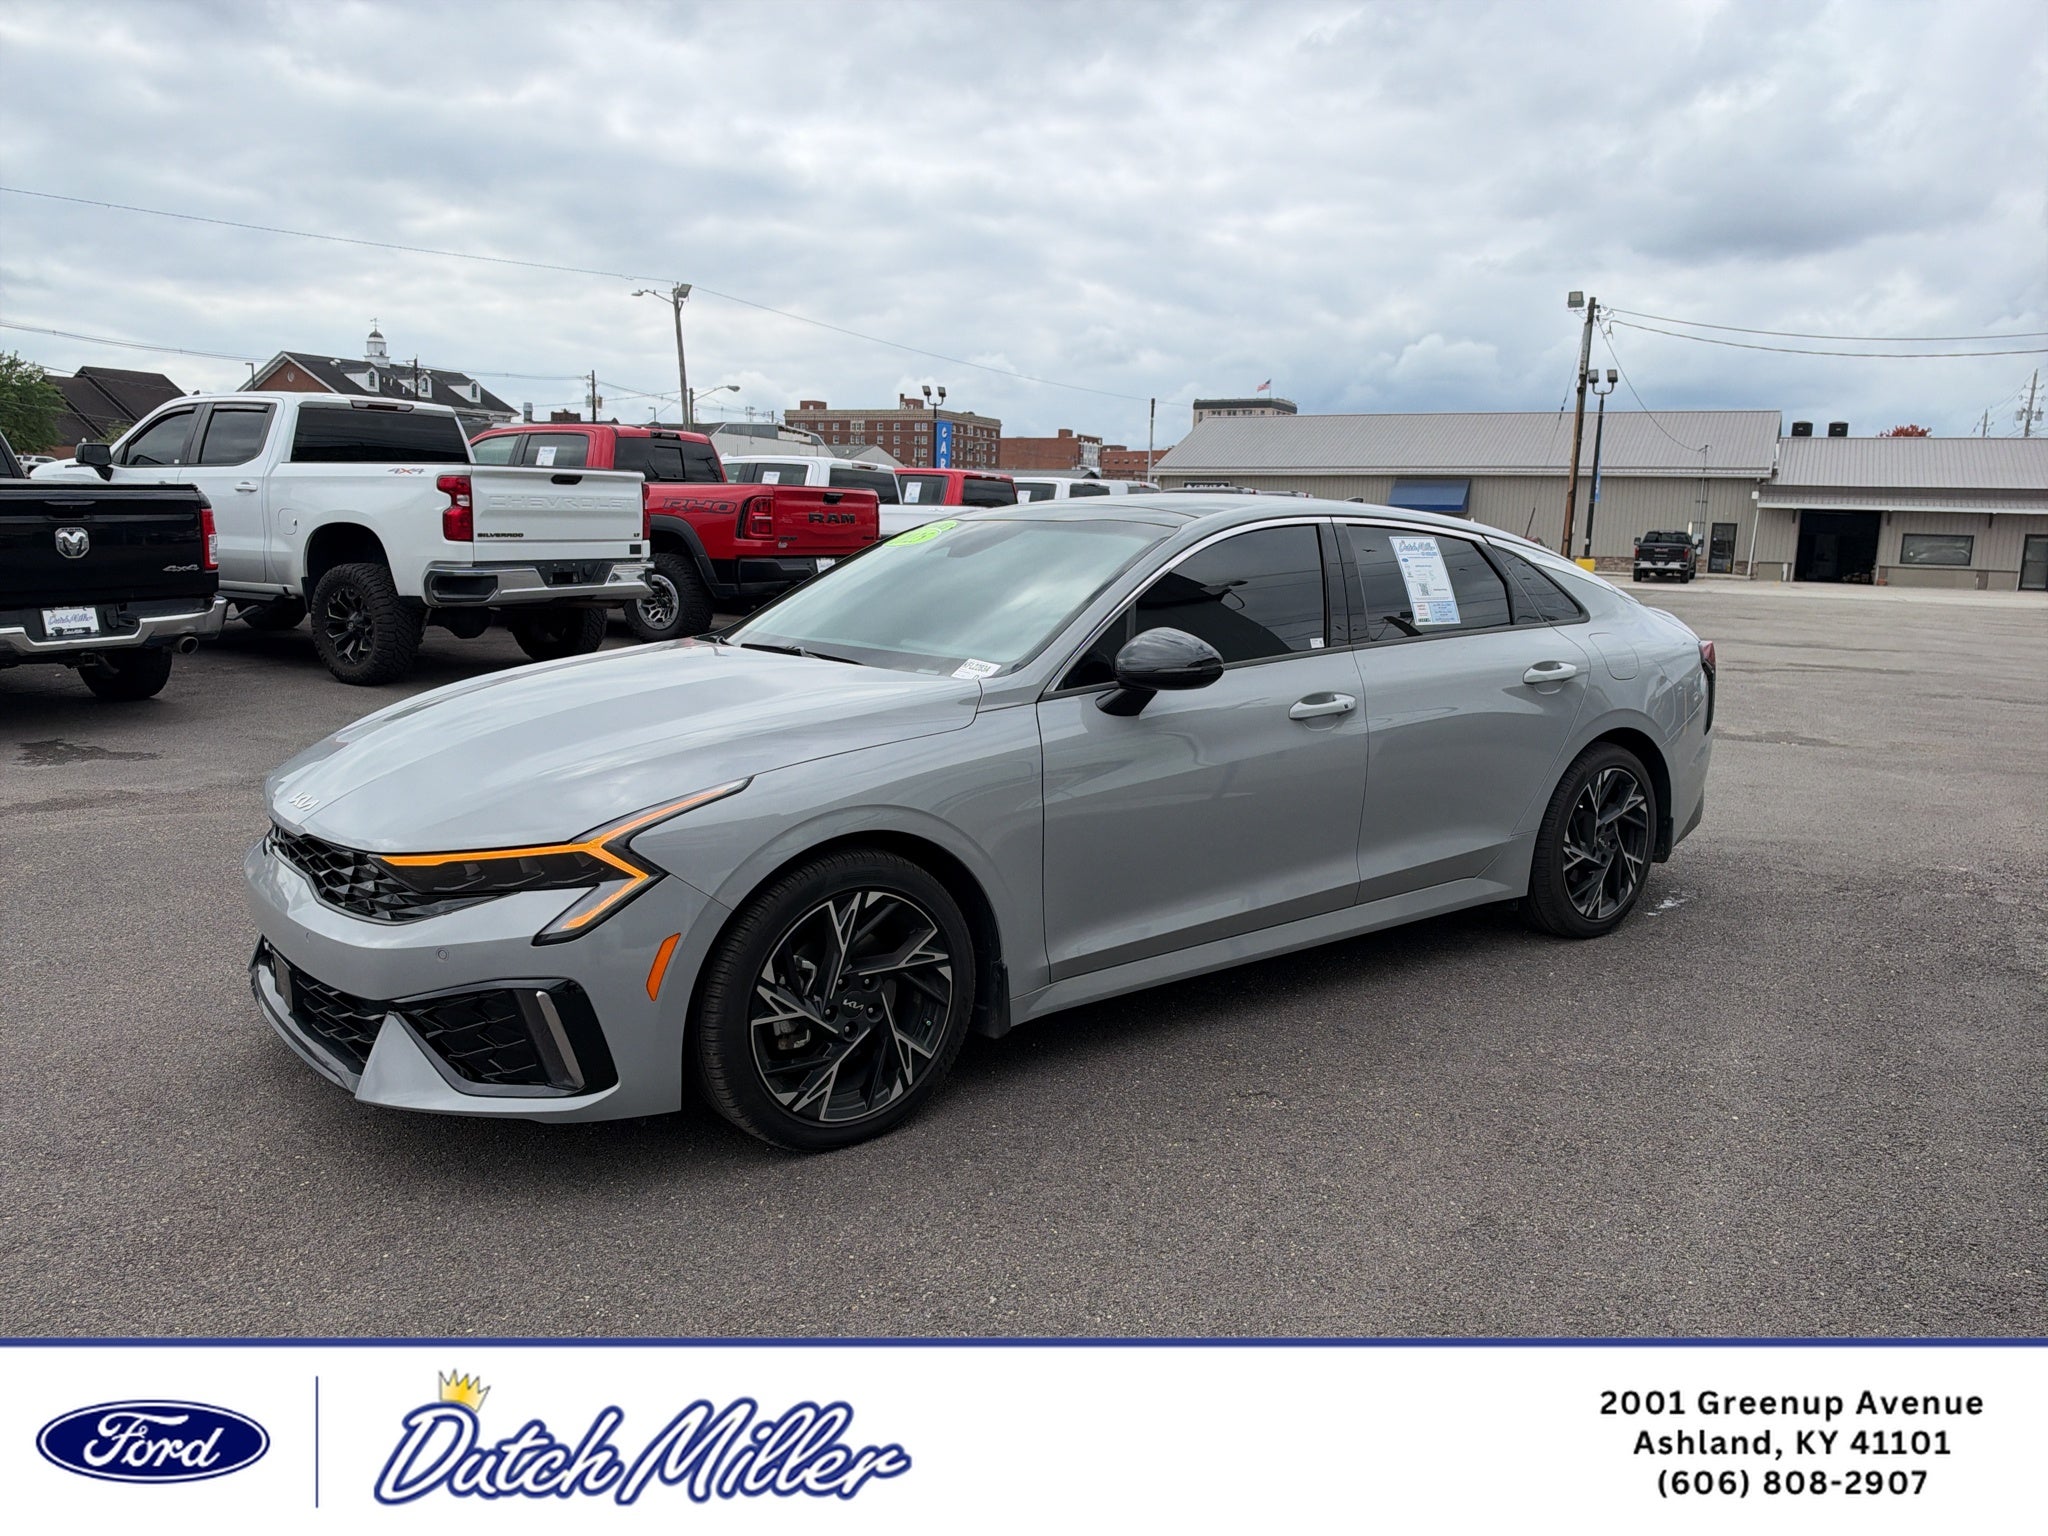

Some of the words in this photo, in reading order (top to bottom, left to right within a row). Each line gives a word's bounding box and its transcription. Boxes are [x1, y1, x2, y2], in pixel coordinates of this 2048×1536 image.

[489, 496, 637, 510] CHEVROLET
[662, 497, 738, 515] RHO
[808, 512, 856, 525] RAM
[842, 999, 865, 1011] KIA
